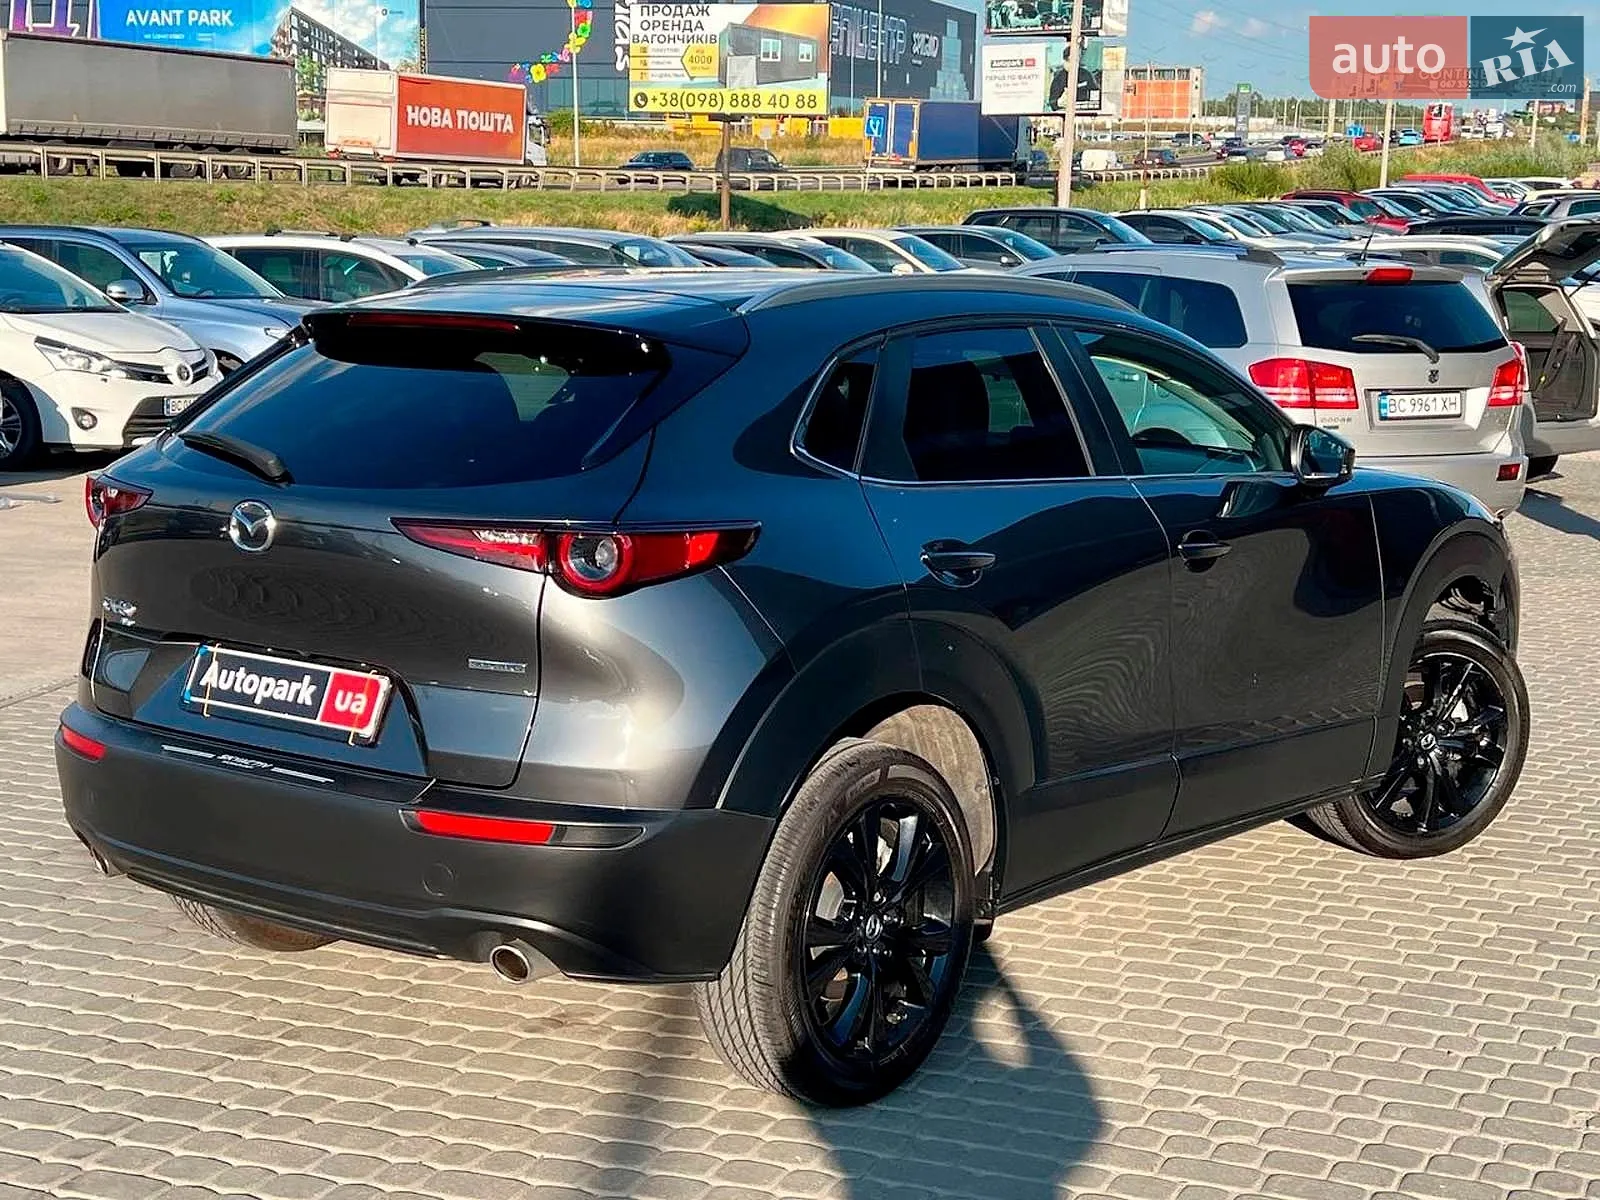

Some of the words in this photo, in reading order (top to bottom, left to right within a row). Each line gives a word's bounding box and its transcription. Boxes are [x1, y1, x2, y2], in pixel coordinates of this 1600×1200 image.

[126, 9, 184, 26] AVANT
[187, 9, 234, 26] PARK
[640, 5, 710, 18] ПРОДАЖ
[640, 20, 704, 33] ОРЕНДА
[632, 34, 717, 44] ВАГОНЧИКІВ
[651, 91, 724, 111] +38(098)
[730, 93, 761, 108] 888
[768, 94, 789, 108] 40
[796, 94, 817, 109] 88
[406, 104, 453, 129] НОВА
[456, 109, 514, 133] ПОШТА
[1389, 398, 1406, 413] BC
[1410, 397, 1437, 412] 9961
[200, 660, 317, 706] Autopark
[334, 688, 368, 715] ua
